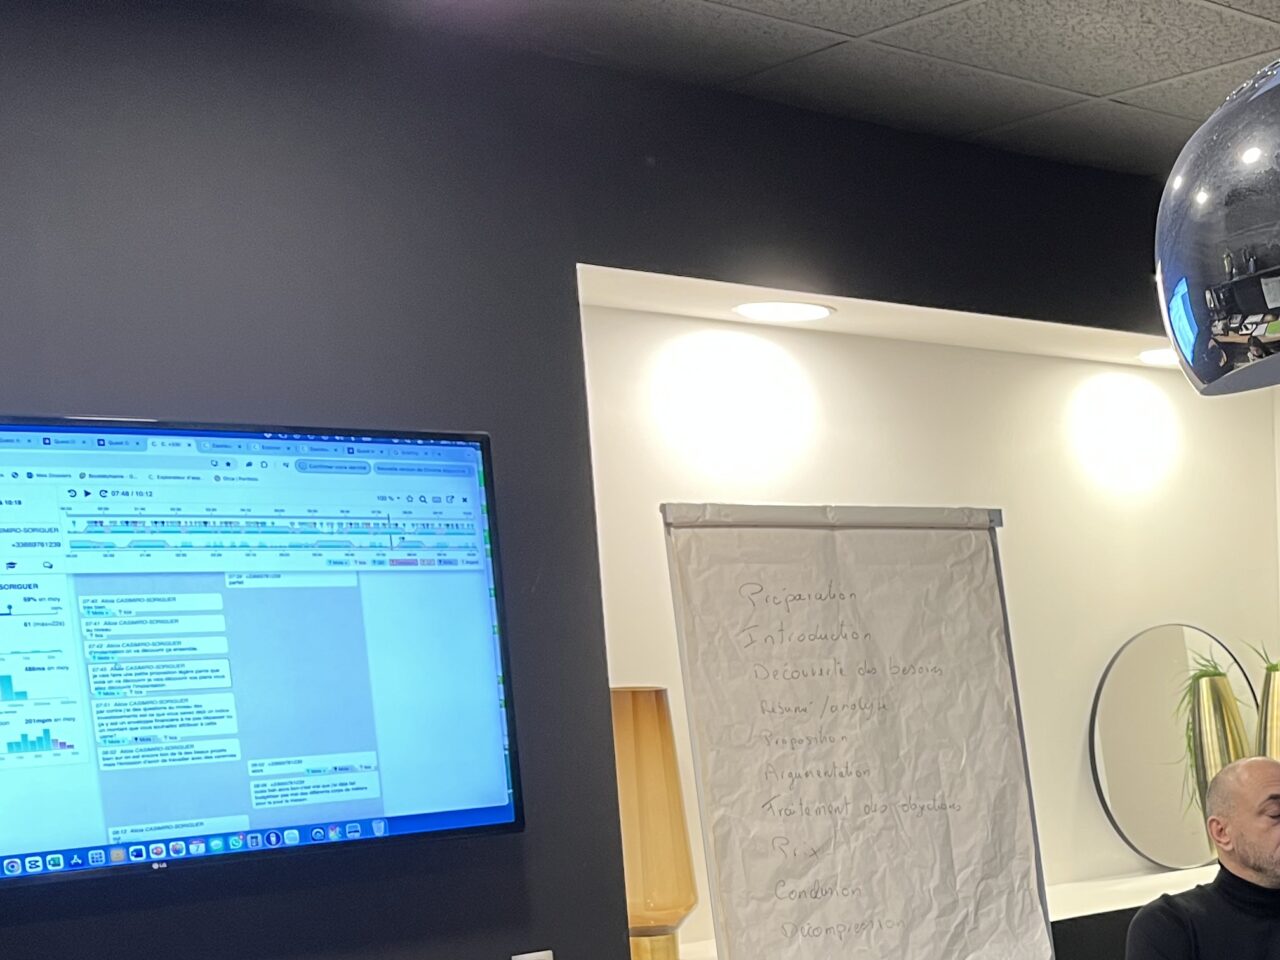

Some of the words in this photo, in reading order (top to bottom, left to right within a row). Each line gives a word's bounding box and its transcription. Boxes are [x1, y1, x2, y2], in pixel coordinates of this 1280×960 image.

[738, 578, 857, 614] Préparation
[738, 620, 872, 649] Introduction
[888, 655, 944, 677] besoins
[760, 725, 848, 750] Proposition
[764, 761, 871, 791] Argumentation
[761, 793, 851, 817] Traitement
[771, 836, 821, 859] Prix
[774, 879, 862, 901] Conclusion
